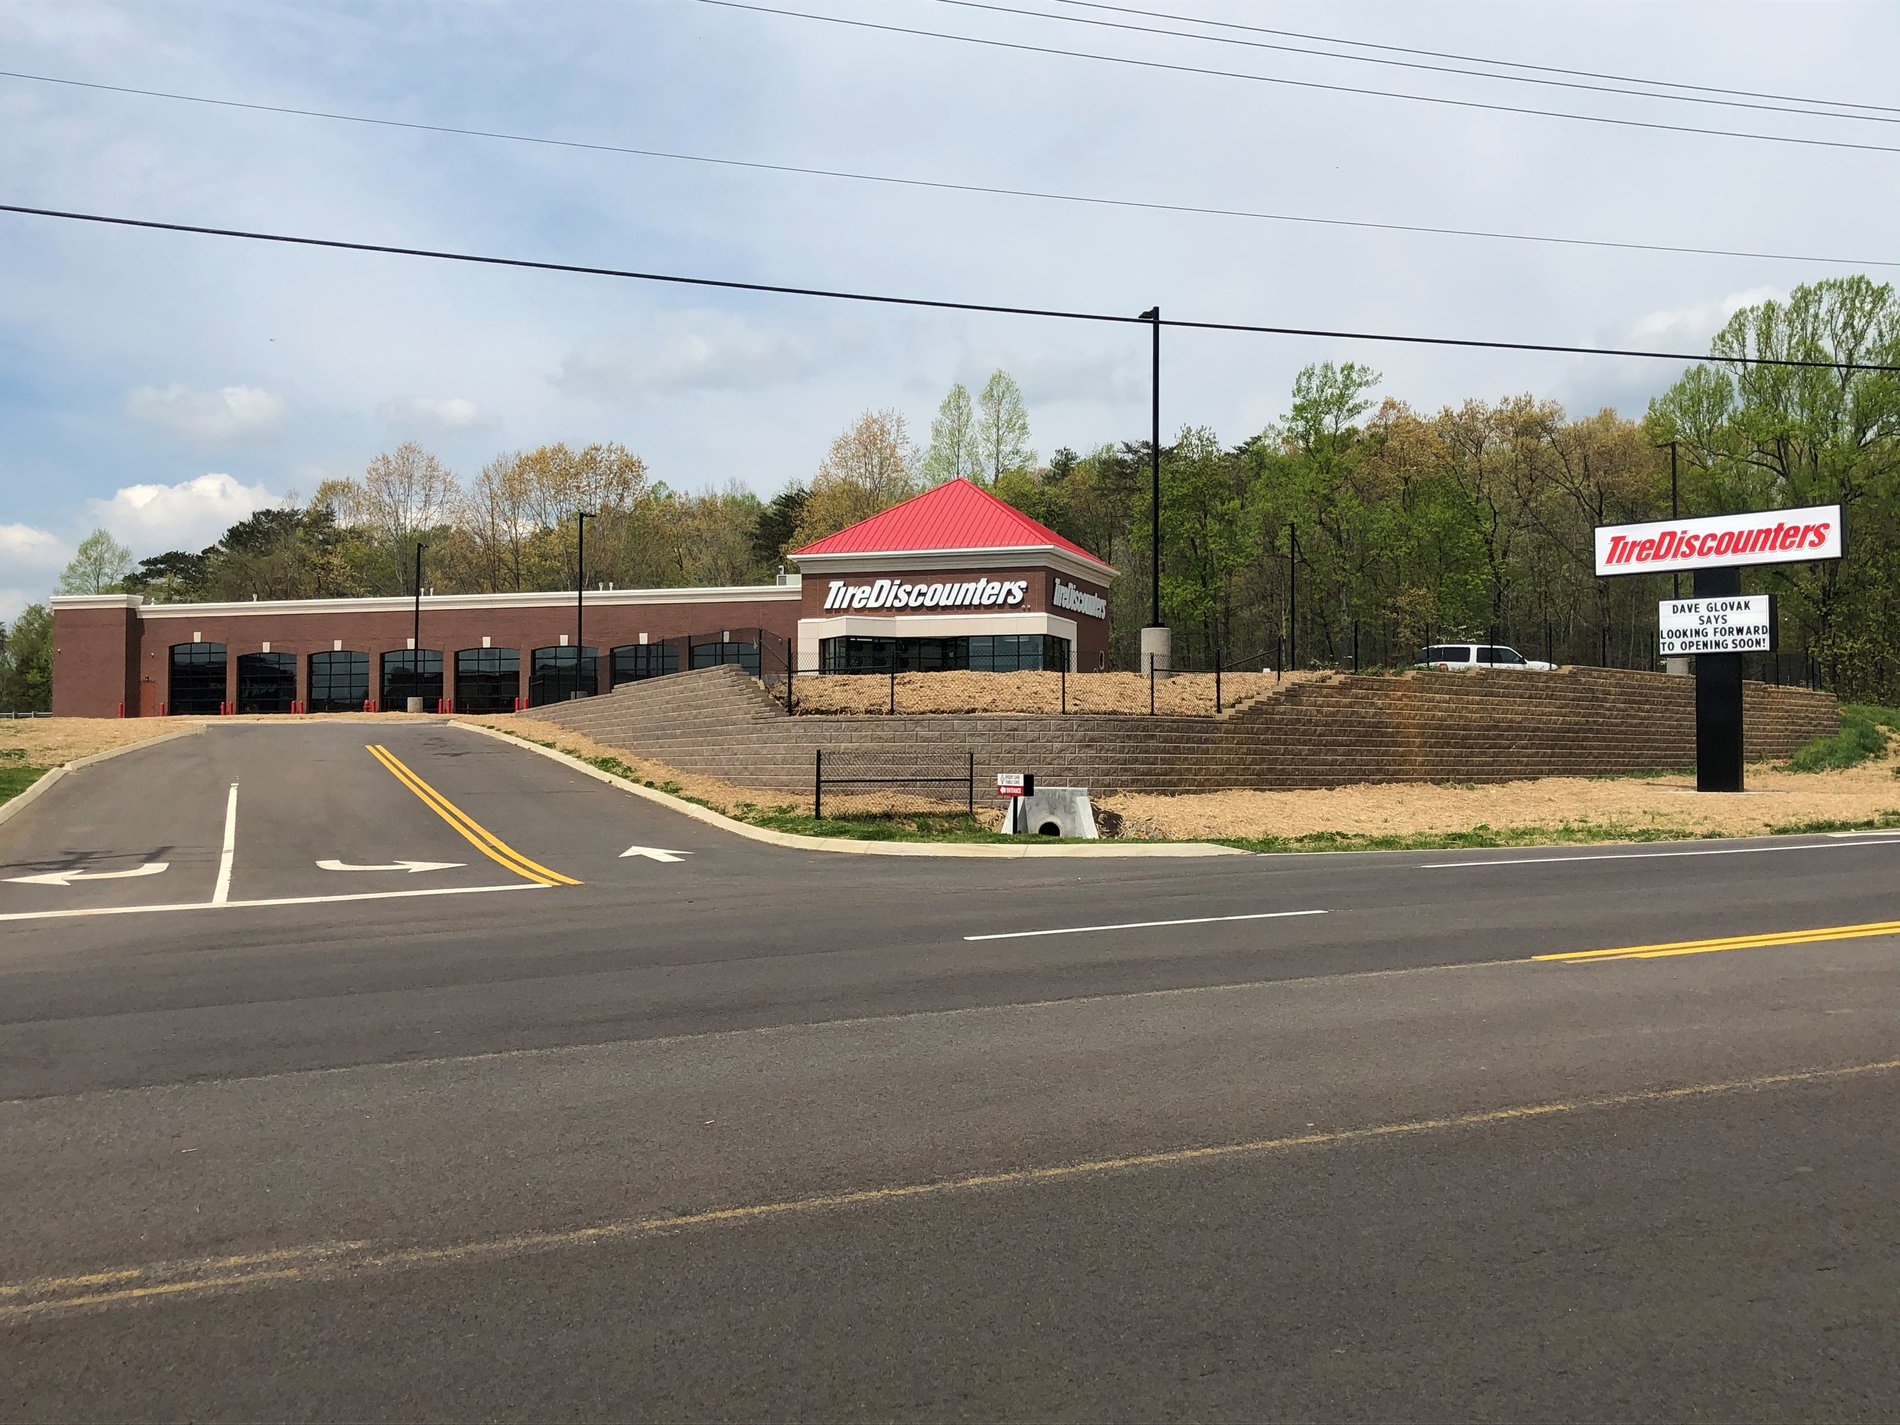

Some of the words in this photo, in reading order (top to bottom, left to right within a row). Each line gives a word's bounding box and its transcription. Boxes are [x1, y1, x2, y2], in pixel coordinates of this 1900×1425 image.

[1605, 522, 1830, 565] TireDiscounters
[823, 577, 1028, 610] TireDiscounters
[1053, 578, 1107, 619] TireDiscounters
[1672, 603, 1700, 614] DAVE
[1706, 600, 1751, 613] GLOVAK
[1698, 614, 1728, 625] SAYS
[1660, 628, 1708, 640] LOOKING
[1713, 625, 1768, 637] FORWARD
[1661, 642, 1675, 652] TO
[1680, 640, 1729, 651] OPENING
[1731, 638, 1767, 649] SOON!
